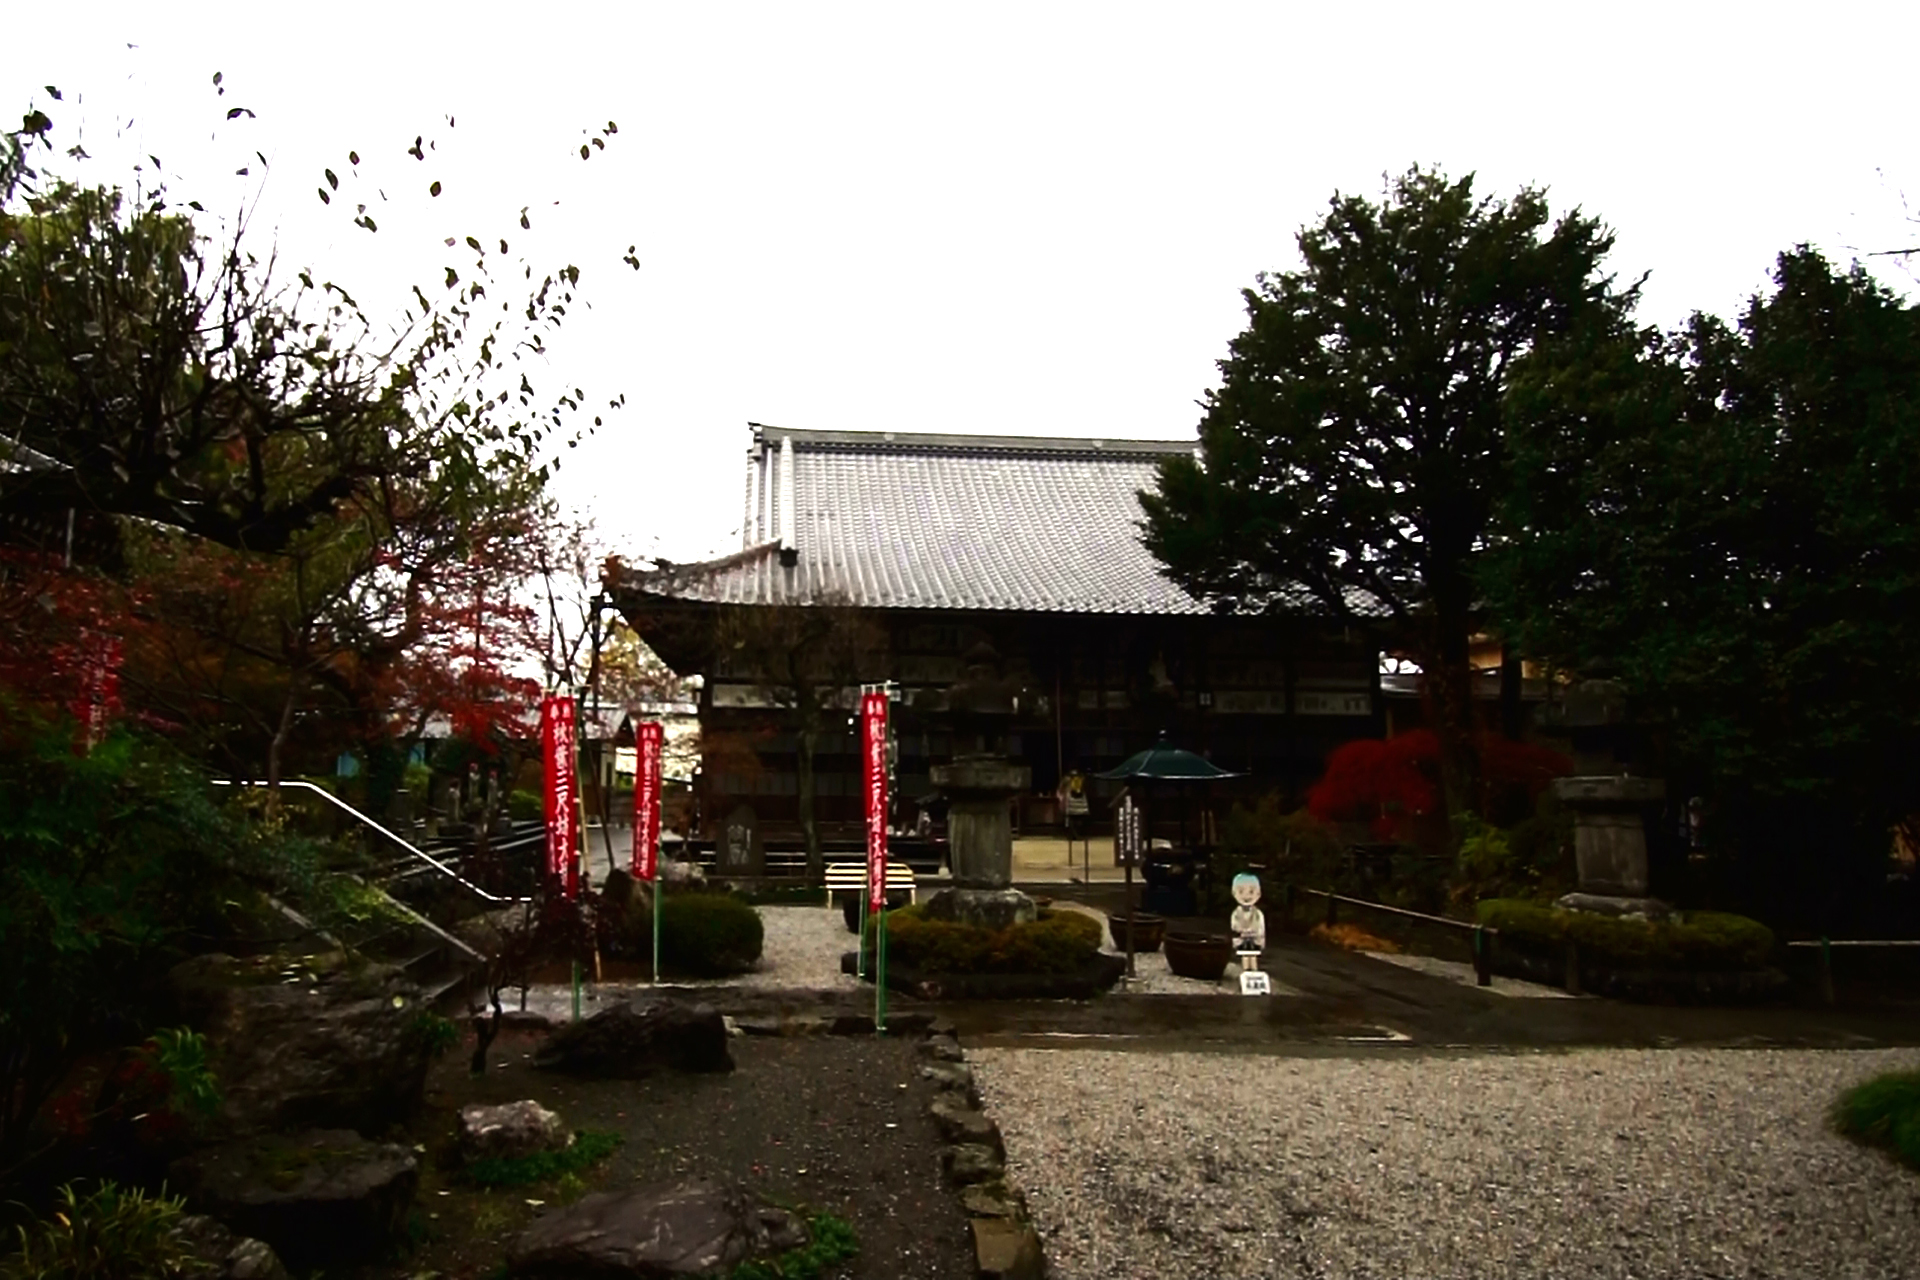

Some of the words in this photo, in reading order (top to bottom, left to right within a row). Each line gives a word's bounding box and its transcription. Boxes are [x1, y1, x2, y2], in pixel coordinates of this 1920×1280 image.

[554, 721, 570, 887] 秋葉三尺坊大
